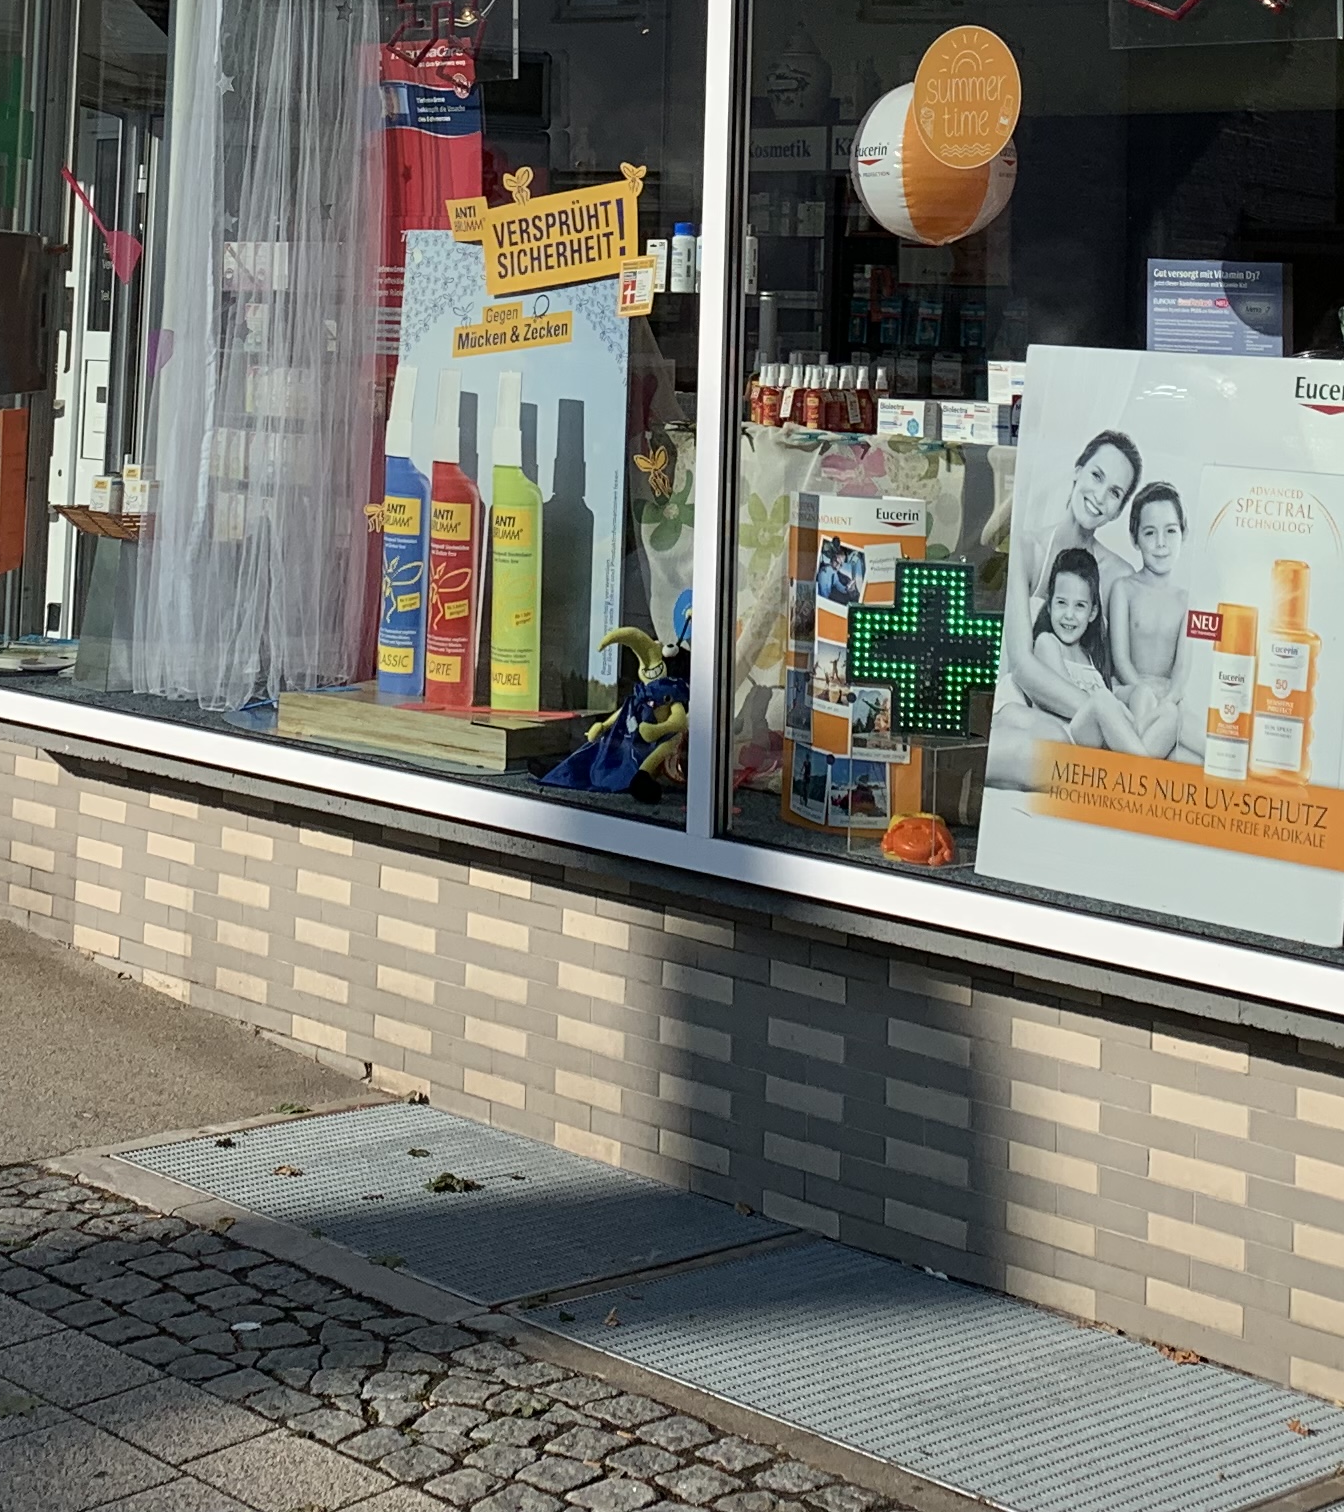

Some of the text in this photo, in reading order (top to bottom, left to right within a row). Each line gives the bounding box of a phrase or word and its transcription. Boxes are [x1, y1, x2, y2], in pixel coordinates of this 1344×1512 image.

[924, 74, 1006, 105] summer
[943, 106, 990, 137] time
[855, 142, 888, 157] Eucerin
[455, 205, 476, 219] ANTI
[492, 199, 612, 249] VERSPRÜHT
[1153, 268, 1167, 279] Gut
[1168, 269, 1199, 280] versorgt
[1199, 269, 1214, 279] mit
[1214, 269, 1244, 280] Vitamin
[486, 306, 519, 325] Gegen
[457, 321, 569, 351] Mücken & Zecken
[880, 402, 905, 411] Biolectra
[943, 405, 968, 414] Biolectra
[1249, 486, 1304, 500] ADVANCED
[387, 503, 406, 515] ANTI
[433, 508, 454, 521] ANTI
[876, 507, 920, 522] Eucerin
[1236, 497, 1315, 520] SPECTRAL
[495, 515, 516, 528] ANTI
[1235, 516, 1314, 535] TECHNOLOGY
[1191, 614, 1219, 632] NEU
[1271, 644, 1299, 656] Eucerin
[378, 651, 410, 668] ASSIC
[427, 660, 453, 676] ORTE
[493, 672, 522, 686] ATUREL
[1218, 671, 1245, 683] Eucerin
[1051, 760, 1329, 830] MEHR ALS NUR UV-SCHUTZ
[1049, 786, 1327, 849] HOCHWIRKSAM AUCH GEGEN FREIE RADIKALE
